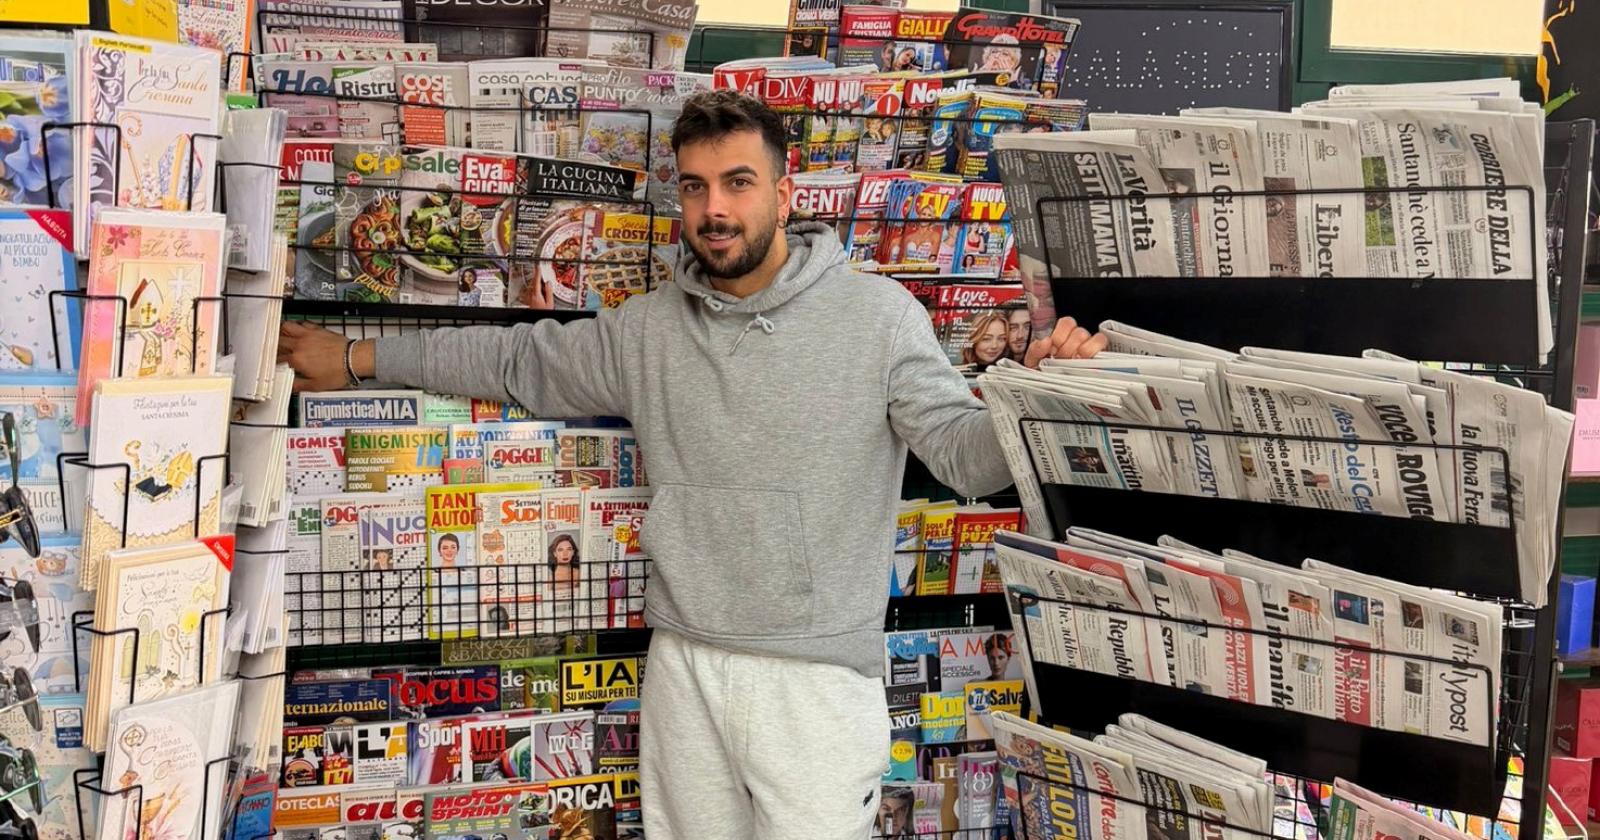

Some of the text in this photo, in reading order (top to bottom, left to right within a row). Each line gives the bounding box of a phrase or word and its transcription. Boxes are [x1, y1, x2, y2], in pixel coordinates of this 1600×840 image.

[266, 3, 399, 31] ASCIUGAMANI
[852, 21, 892, 30] FAMIGLIA
[478, 74, 519, 85] casa
[1176, 51, 1278, 89] SLOT
[341, 80, 396, 97] Ristru
[401, 73, 452, 91] COSE
[648, 76, 674, 86] PACK
[403, 90, 456, 107] CASA
[528, 86, 577, 105] CAS
[584, 87, 636, 100] PUNTO
[813, 80, 836, 104] NU
[838, 80, 862, 103] NU
[466, 158, 502, 180] Eva
[538, 163, 626, 185] LA CUCINA
[542, 178, 618, 196] ITALIANA
[917, 191, 950, 218] TV
[971, 202, 1007, 221] TV
[1470, 133, 1512, 275] CORRIERE DELLA
[1208, 160, 1235, 277] il Giorna
[605, 228, 670, 243] CROSTATE
[1411, 216, 1433, 255] cede
[953, 288, 989, 302] Love
[1176, 397, 1198, 417] IL
[1461, 423, 1482, 438] la
[348, 456, 369, 465] PAROLE
[1266, 461, 1281, 475] per
[1346, 455, 1367, 481] del
[431, 493, 476, 509] TANT
[1263, 602, 1290, 622] il
[1234, 618, 1246, 663] RGAZZI
[501, 669, 525, 688] de
[565, 661, 636, 690] L'IA
[565, 692, 577, 702] SU
[578, 688, 608, 700] MISURA
[608, 687, 625, 698] PER
[1350, 679, 1369, 713] Fatto
[469, 726, 508, 752] MH
[431, 793, 502, 809] MOTO
[430, 804, 514, 823] SPRINT
